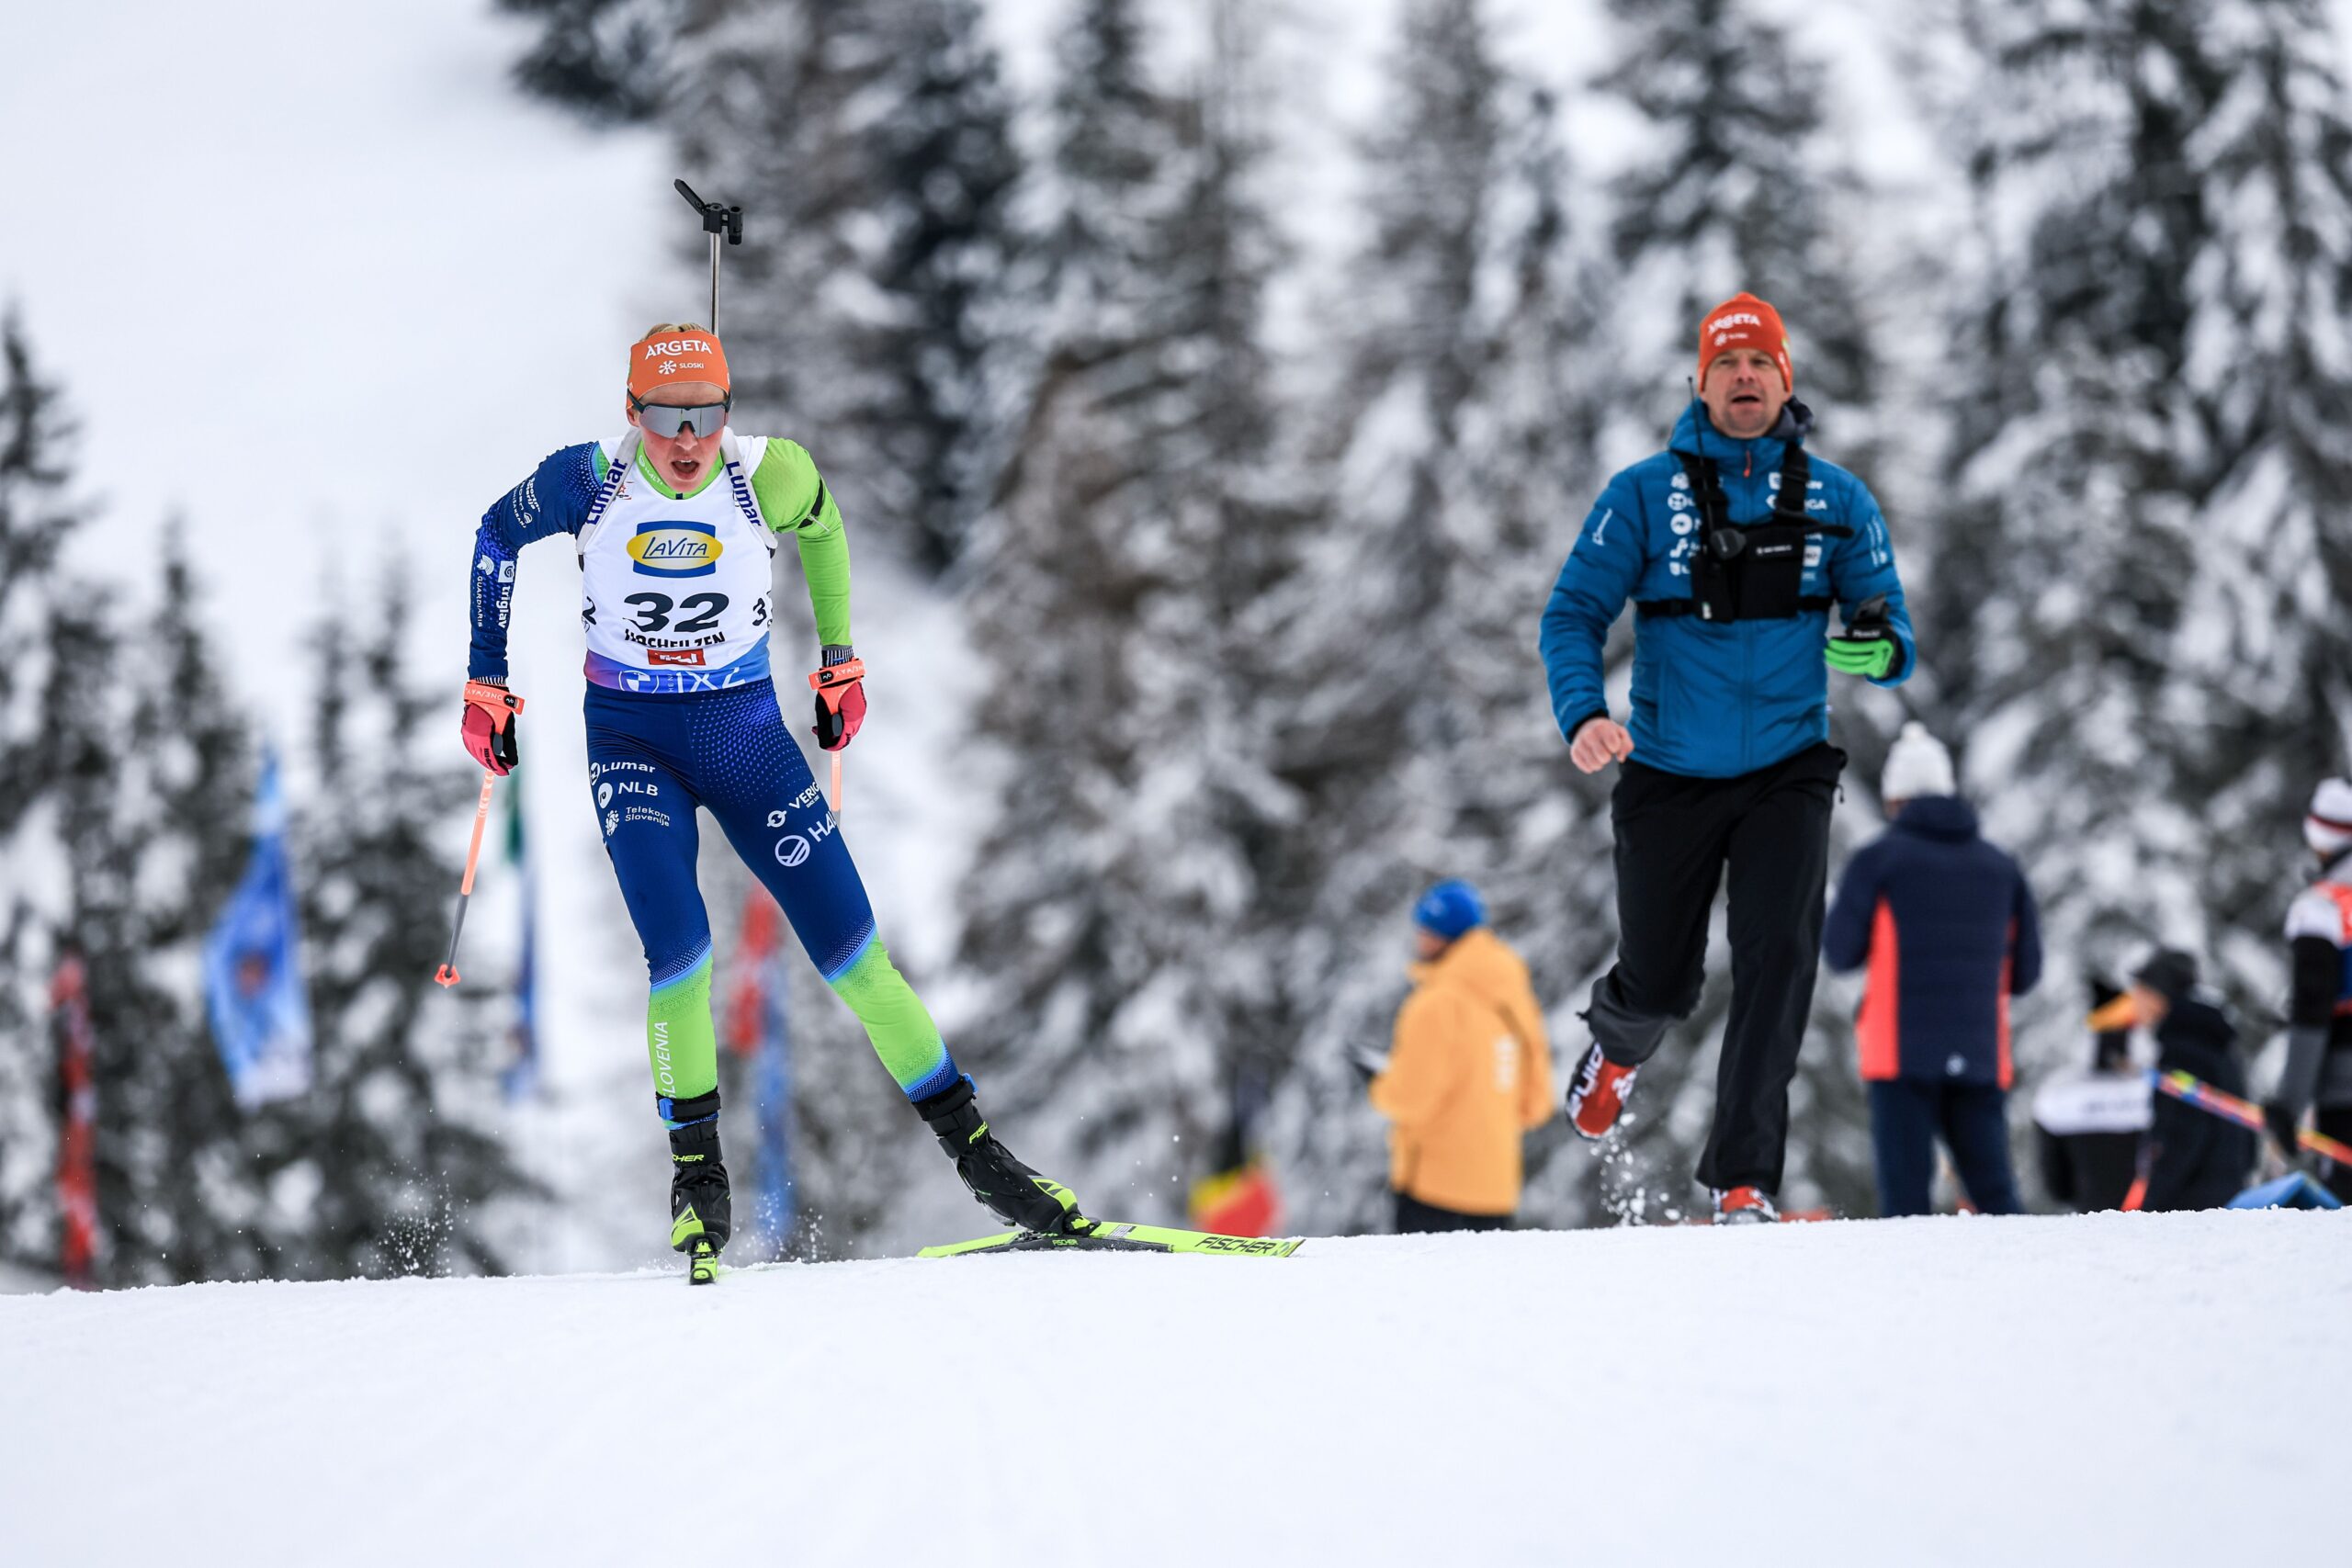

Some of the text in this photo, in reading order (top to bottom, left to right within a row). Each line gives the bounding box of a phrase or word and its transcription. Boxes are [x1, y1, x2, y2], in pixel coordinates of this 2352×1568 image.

[645, 339, 713, 360] ARGETA
[586, 458, 628, 525] Lumar
[726, 461, 762, 526] Lumar
[496, 585, 511, 629] triglav
[622, 592, 729, 633] 32
[602, 761, 656, 773] Lumar
[617, 781, 660, 797] NLB
[625, 814, 671, 827] Slovenije
[626, 806, 671, 821] Telekom
[1194, 1236, 1277, 1255] FISCHER
